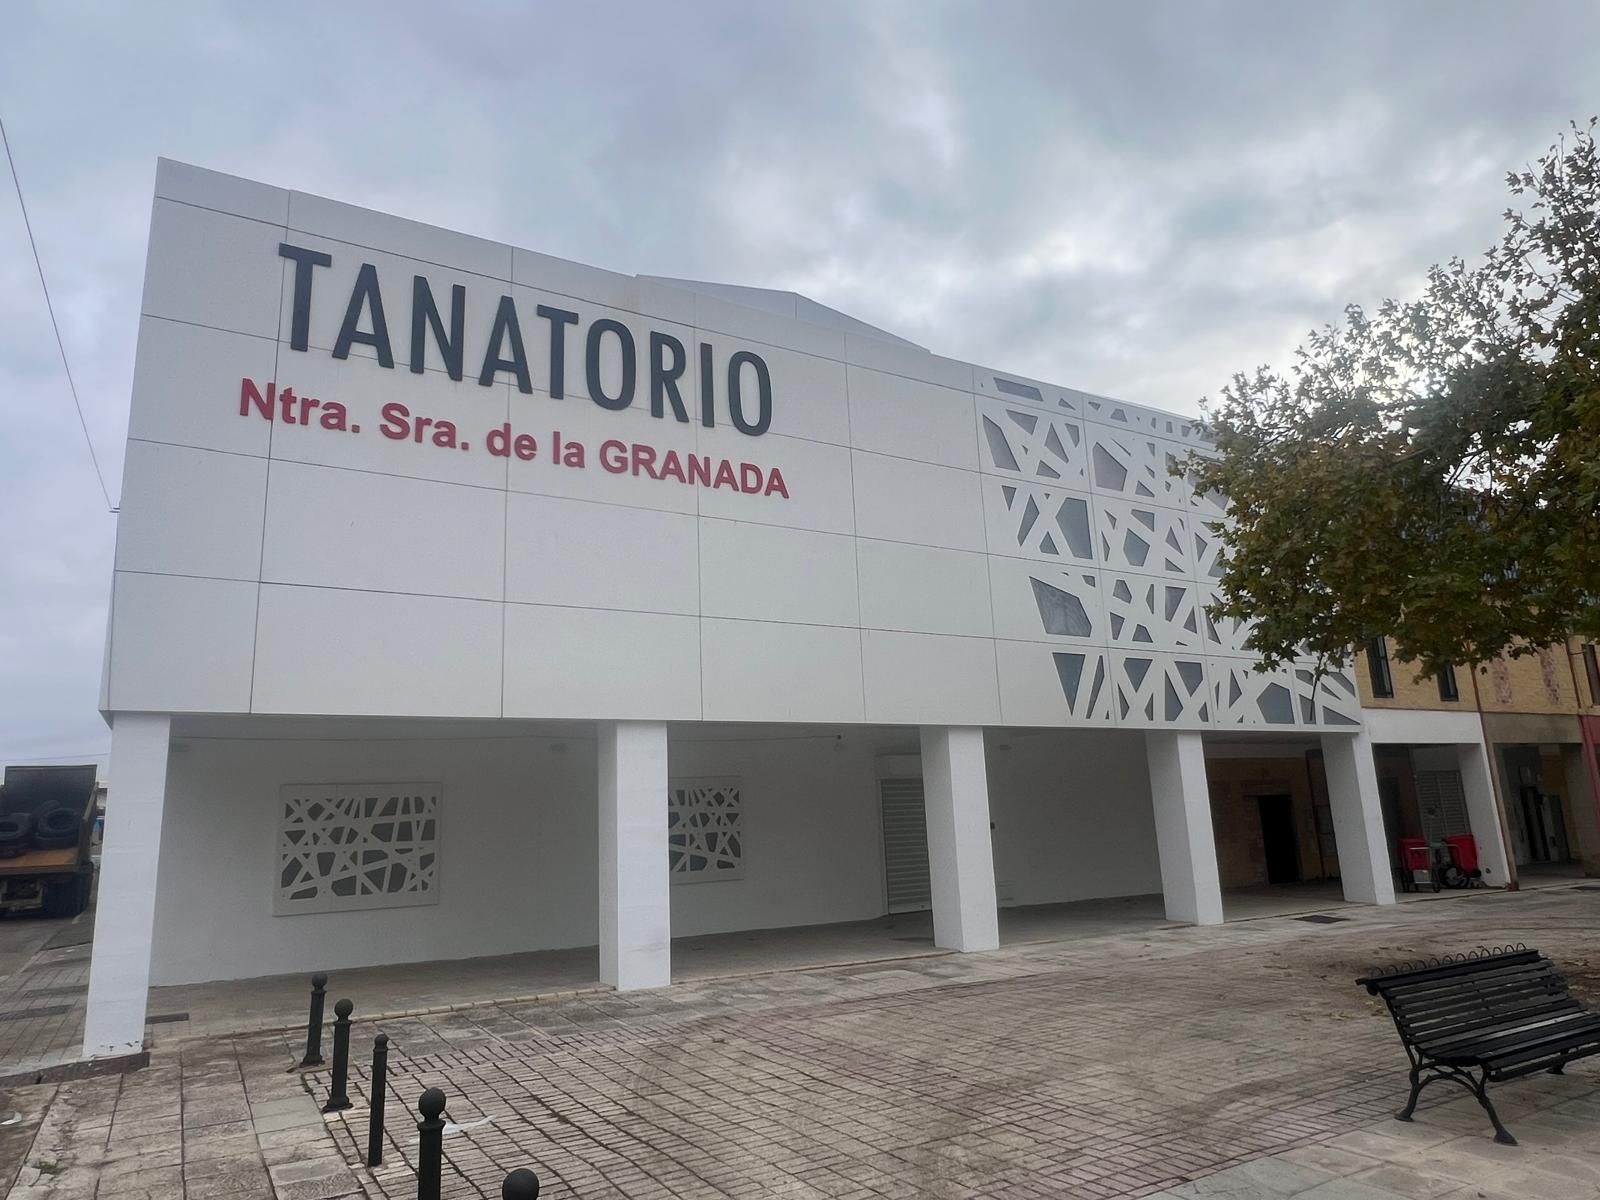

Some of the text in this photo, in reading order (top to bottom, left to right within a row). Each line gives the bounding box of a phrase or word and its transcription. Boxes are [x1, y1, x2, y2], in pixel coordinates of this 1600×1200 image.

[278, 242, 772, 437] TANATORIO
[239, 378, 790, 499] Ntra. Sra. de la GRANADA
